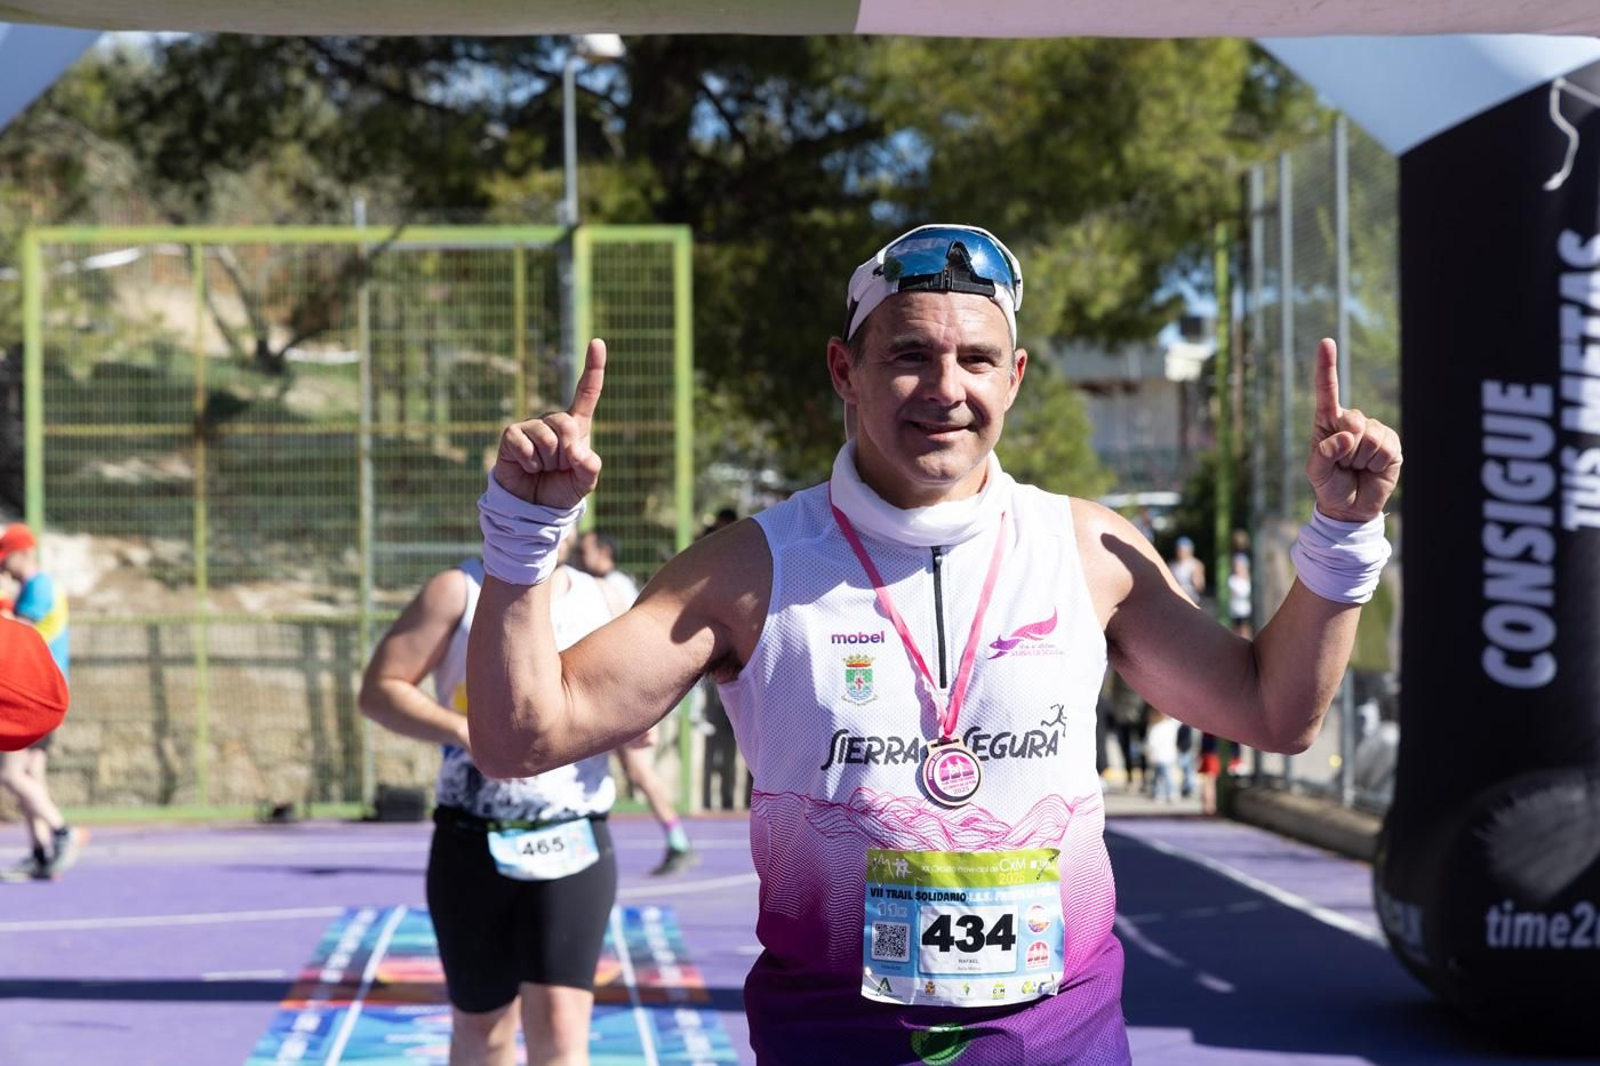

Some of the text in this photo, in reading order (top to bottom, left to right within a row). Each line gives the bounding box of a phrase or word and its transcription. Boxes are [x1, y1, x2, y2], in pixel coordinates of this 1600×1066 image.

[1480, 379, 1558, 688] CONSIGUE
[831, 630, 886, 644] mobel
[820, 728, 921, 771] SIERRA
[522, 836, 565, 856] 465
[870, 888, 883, 898] VII
[886, 889, 913, 900] TRAIL
[915, 892, 967, 902] SOLIDARIO
[922, 913, 1017, 953] 434
[1486, 898, 1600, 949] time2
